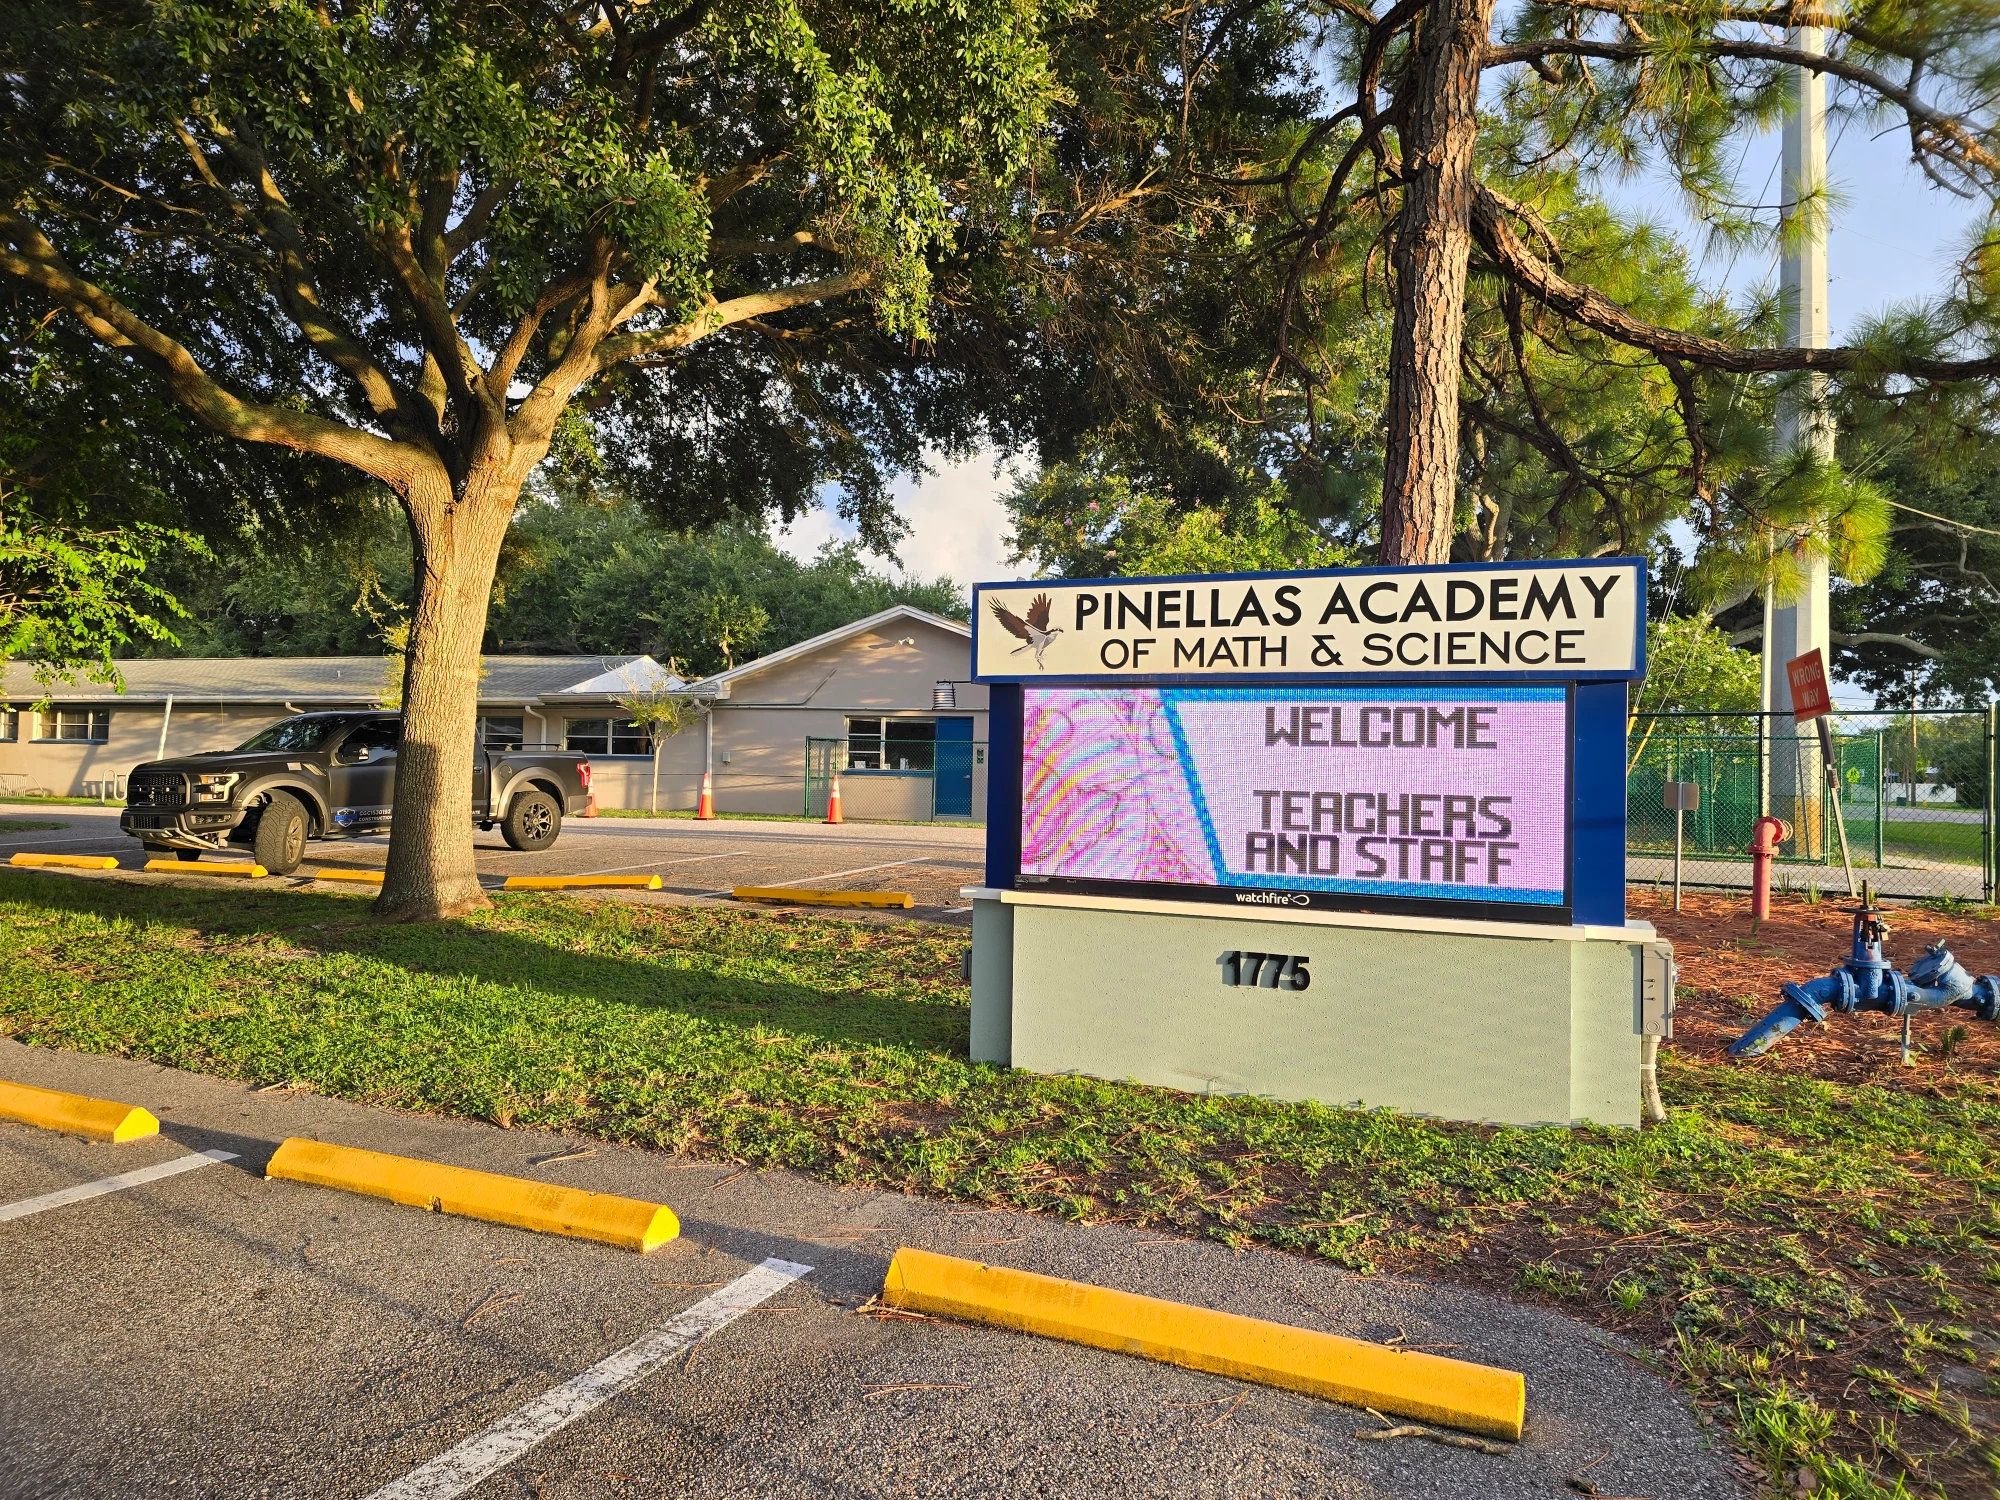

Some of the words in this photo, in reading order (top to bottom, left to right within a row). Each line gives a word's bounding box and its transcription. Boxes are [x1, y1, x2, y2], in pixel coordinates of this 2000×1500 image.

[1075, 586, 1301, 631] PINELLAS
[1318, 574, 1621, 624] ACADEMY
[1100, 638, 1156, 669] OF
[1173, 636, 1287, 668] MATH
[1311, 634, 1343, 667] &
[1361, 630, 1586, 667] SCIENCE
[1792, 661, 1821, 688] WRONG
[1802, 687, 1820, 709] WAY
[1265, 706, 1498, 749] WELCOME
[1253, 789, 1512, 839] TEACHERS
[1245, 831, 1340, 876] AND
[1355, 836, 1520, 885] STAFF
[1235, 892, 1290, 905] watchfire
[1227, 950, 1311, 991] 1775
